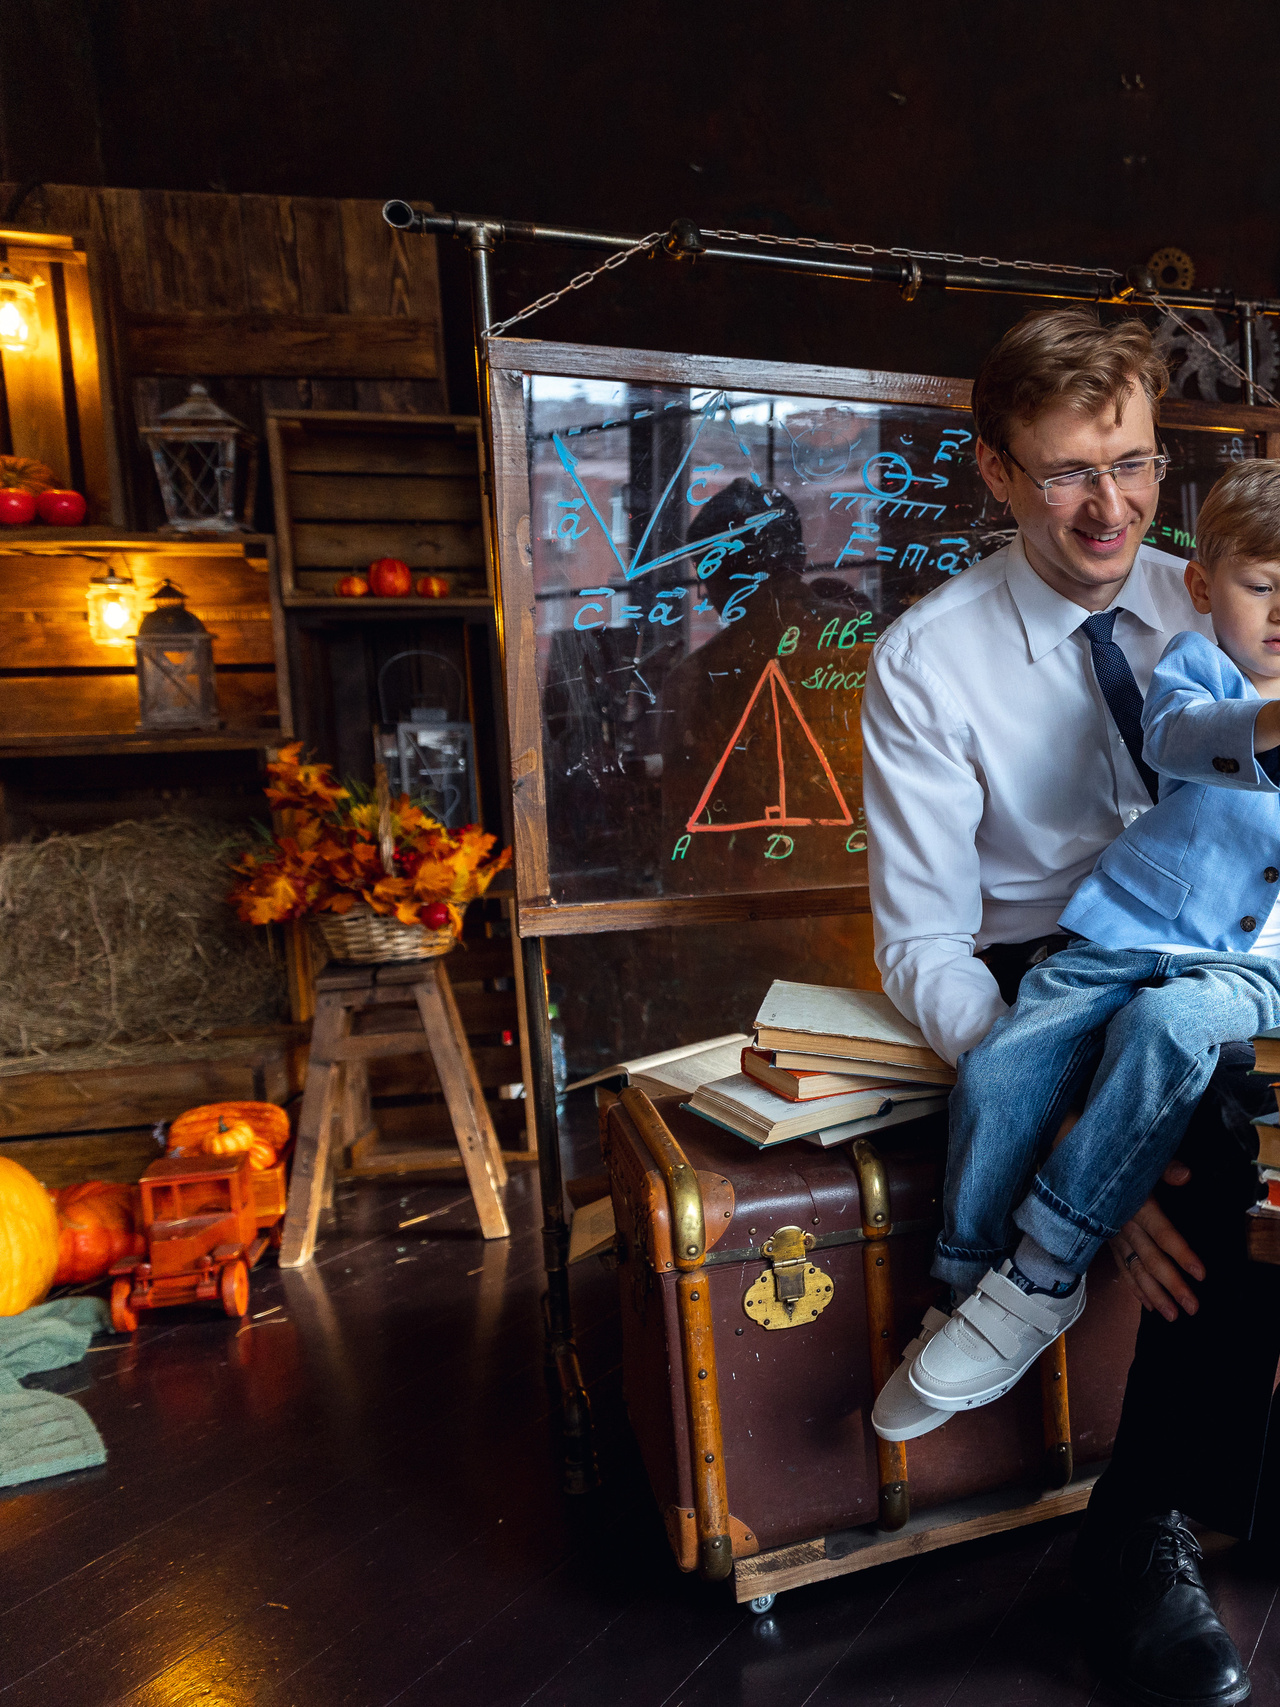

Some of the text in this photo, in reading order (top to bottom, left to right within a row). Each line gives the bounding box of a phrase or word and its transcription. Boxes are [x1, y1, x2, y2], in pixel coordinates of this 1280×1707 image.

[778, 626, 800, 656] B
[671, 833, 692, 861] A
[764, 834, 794, 860] D
